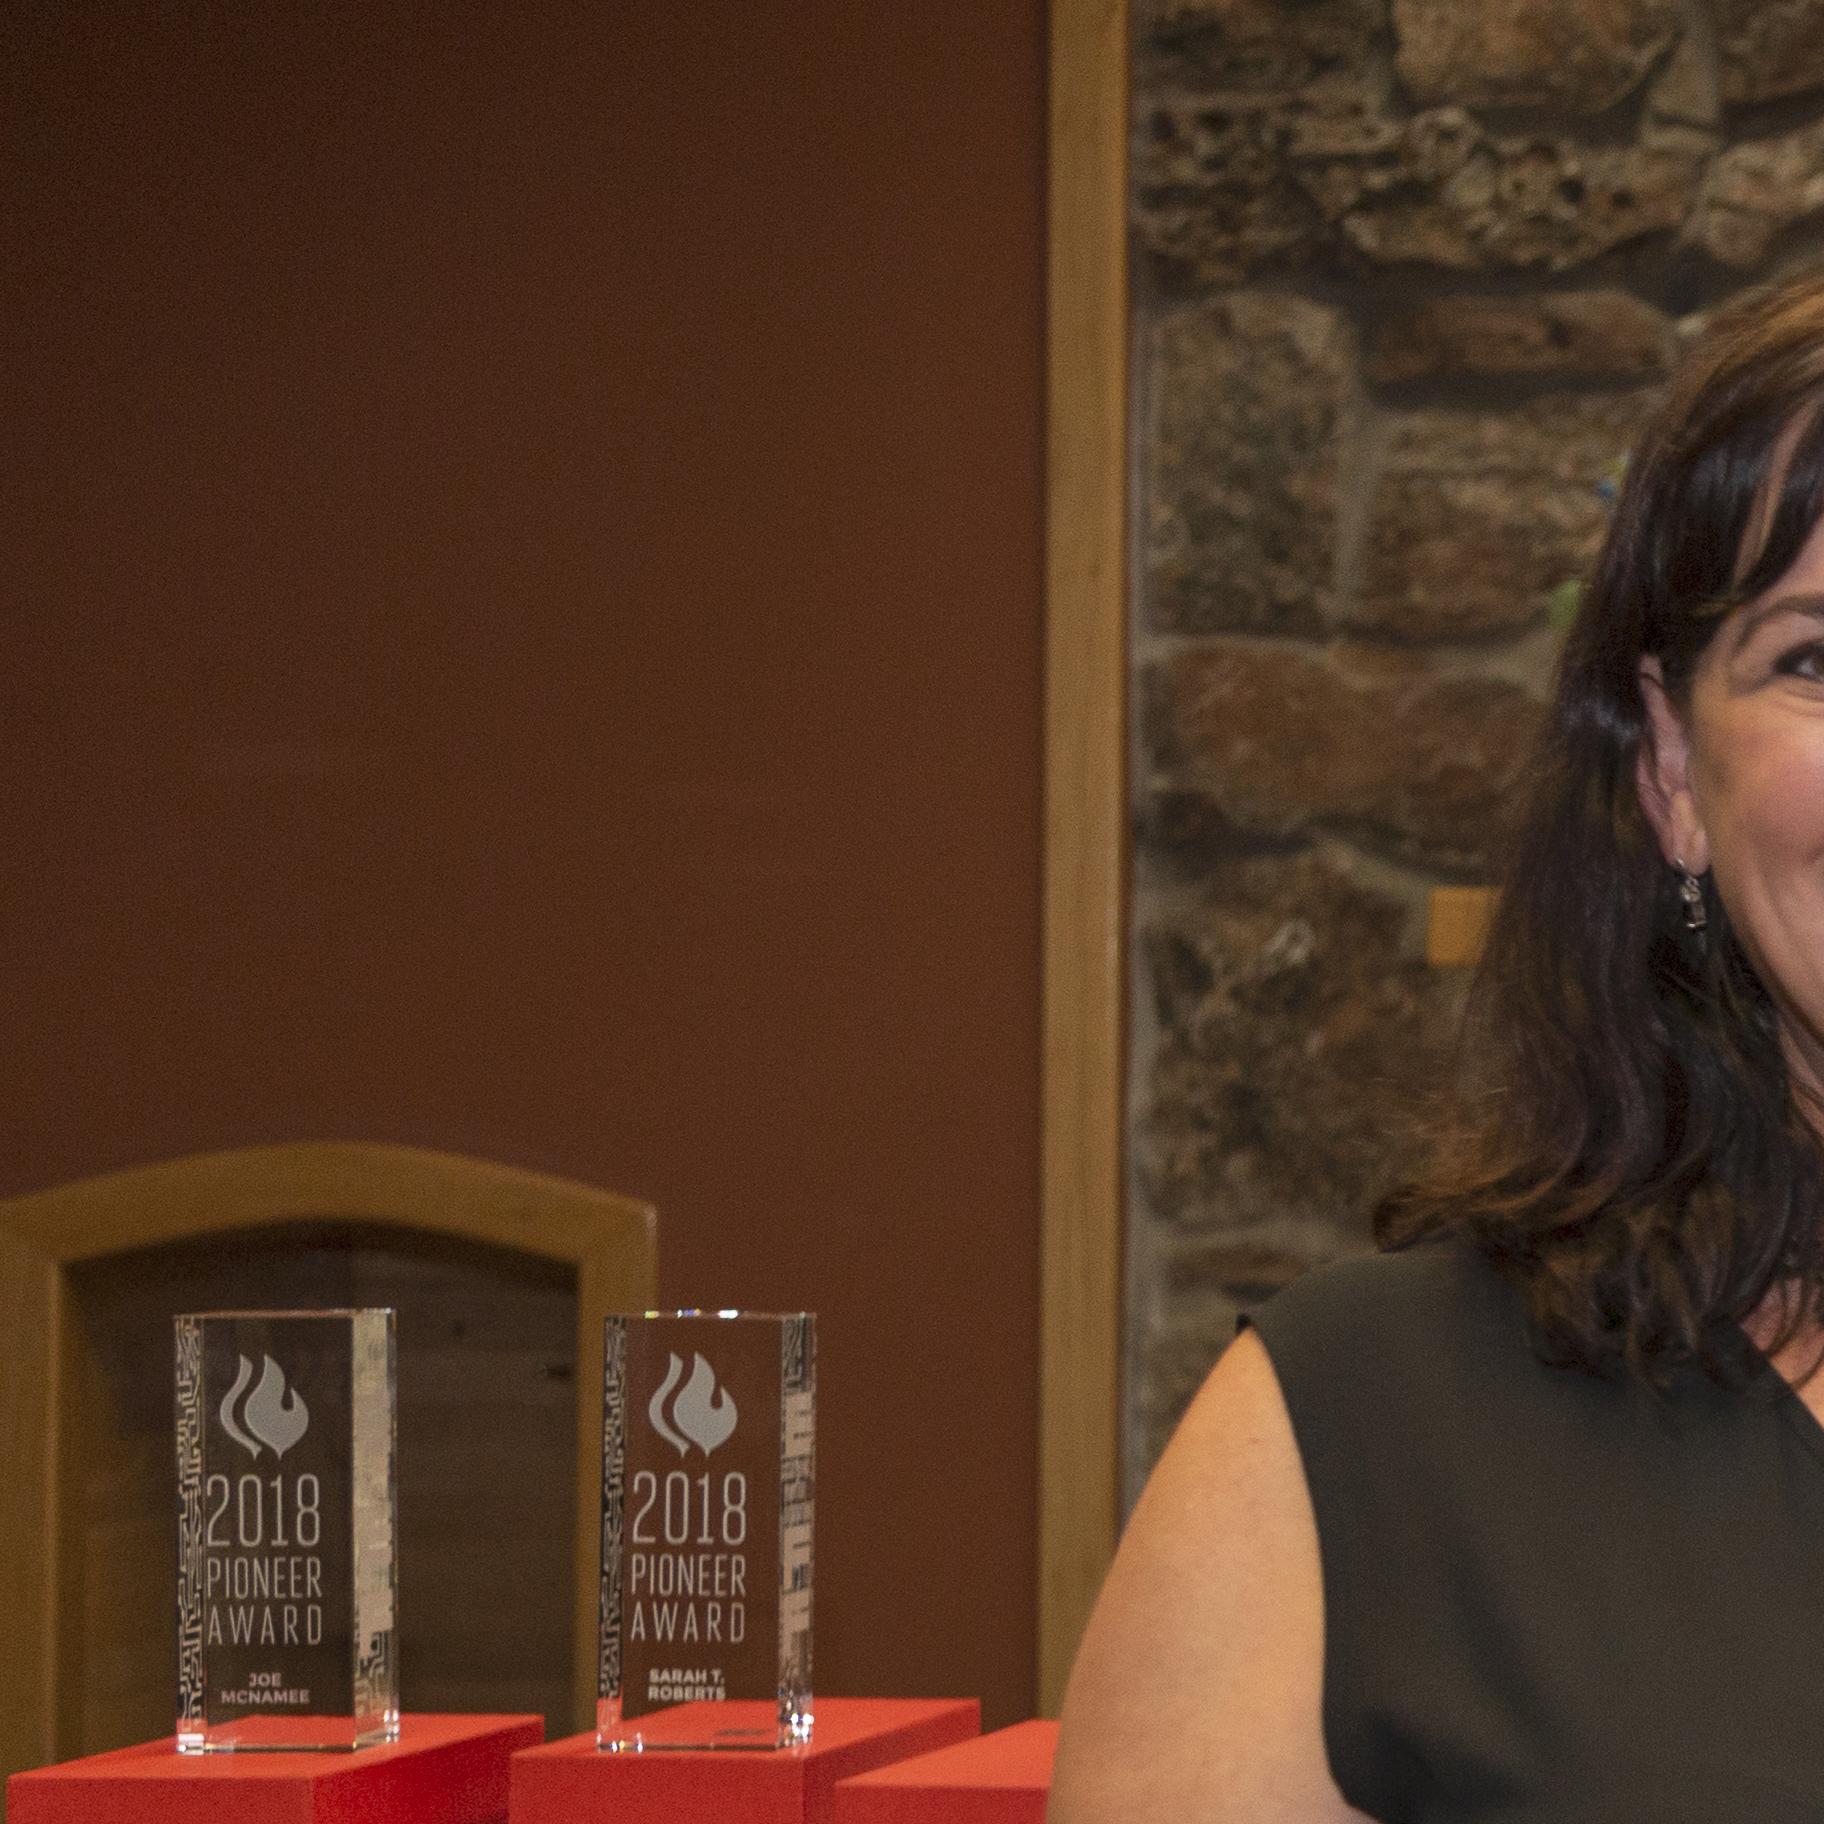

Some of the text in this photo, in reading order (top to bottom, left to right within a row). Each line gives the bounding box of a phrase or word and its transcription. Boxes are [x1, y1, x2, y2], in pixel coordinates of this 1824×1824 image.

[206, 1473, 321, 1547] 2018
[632, 1469, 747, 1546] 2018
[206, 1556, 323, 1600] PIONEER
[631, 1553, 747, 1598] PIONEER
[206, 1604, 323, 1646] AWARD
[630, 1601, 745, 1643] AWARD
[249, 1672, 282, 1688] JOE
[648, 1685, 726, 1701] ROBERTS
[649, 1667, 707, 1684] SARAH
[221, 1689, 310, 1705] MCNAMEE
